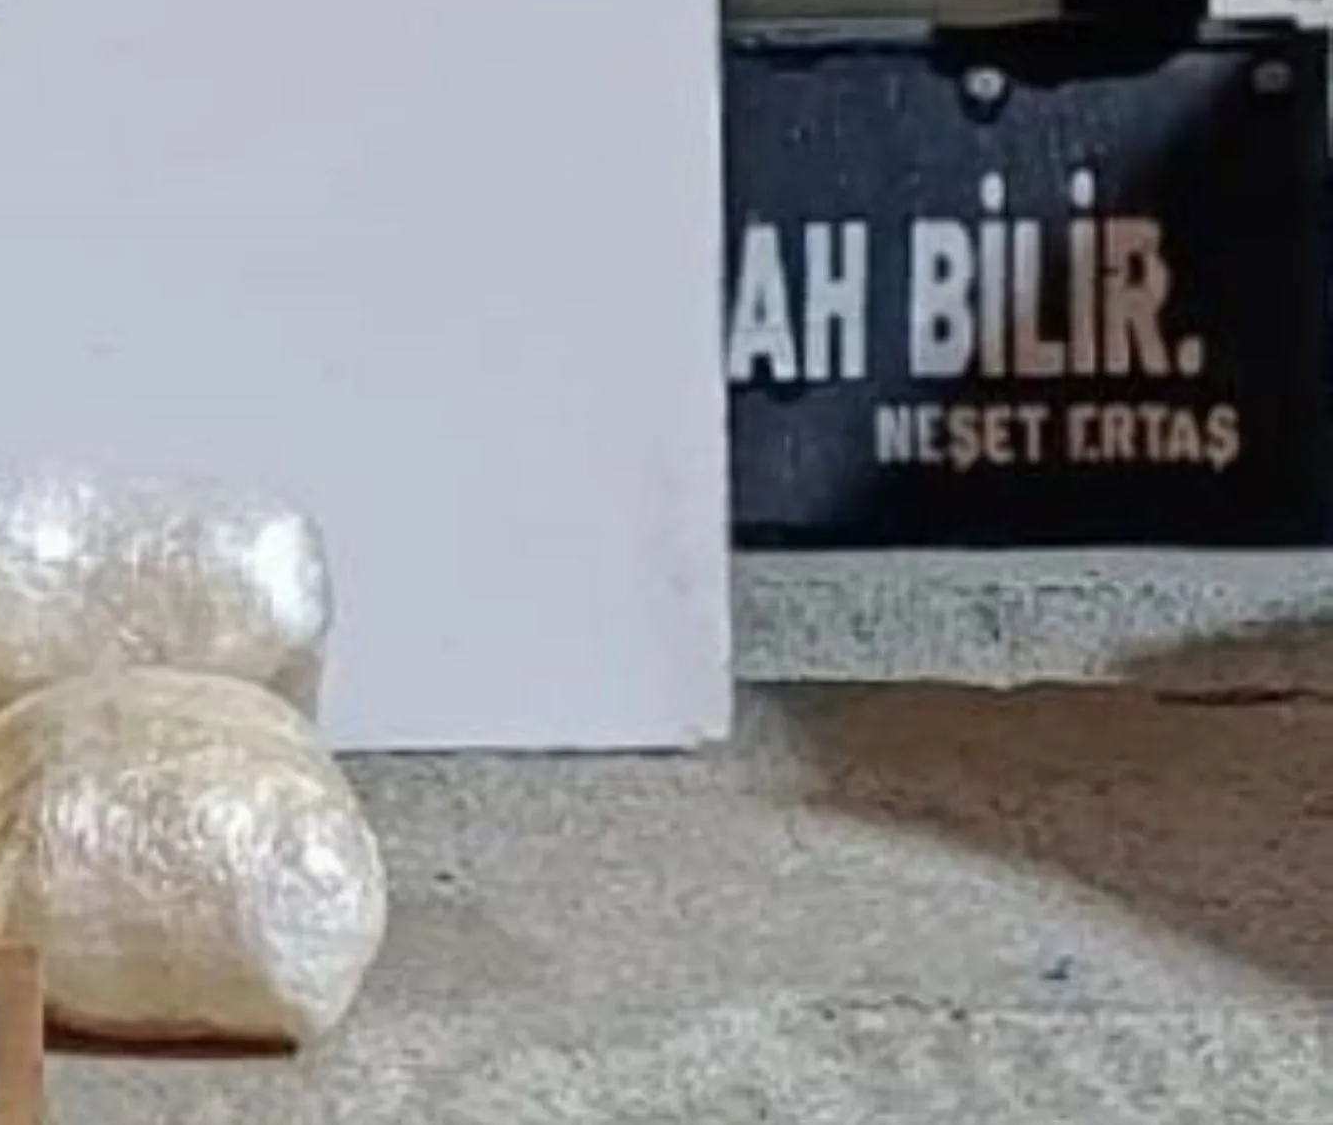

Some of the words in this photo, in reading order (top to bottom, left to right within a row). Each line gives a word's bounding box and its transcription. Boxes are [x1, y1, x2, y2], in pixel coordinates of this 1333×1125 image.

[907, 169, 1205, 378] BİLİR.
[874, 404, 1050, 470] NEŞET
[1068, 403, 1241, 471] ERTAŞ
